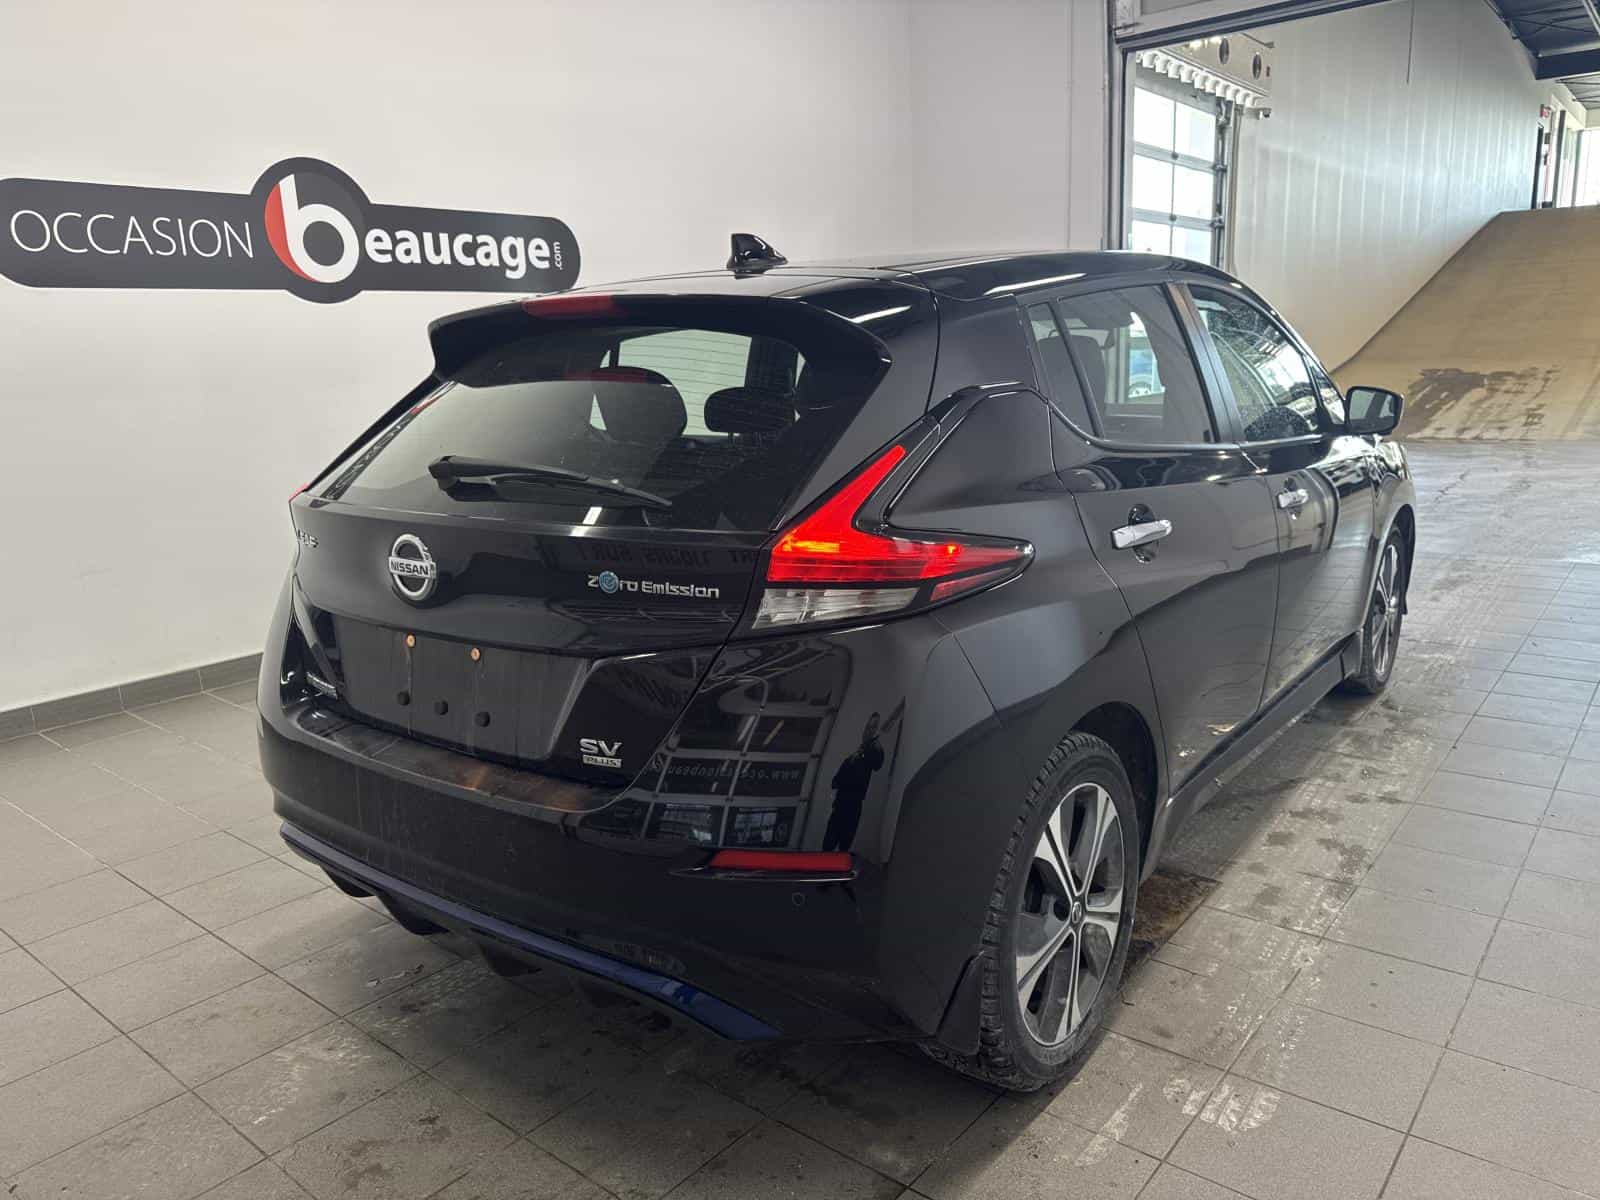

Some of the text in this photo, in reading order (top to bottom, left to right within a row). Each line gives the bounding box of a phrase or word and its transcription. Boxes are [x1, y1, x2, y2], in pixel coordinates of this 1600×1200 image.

[10, 209, 254, 259] OCCASION
[390, 559, 430, 576] NISSAN
[641, 580, 720, 599] Emission
[579, 738, 623, 757] SV
[585, 756, 619, 767] PLUS
